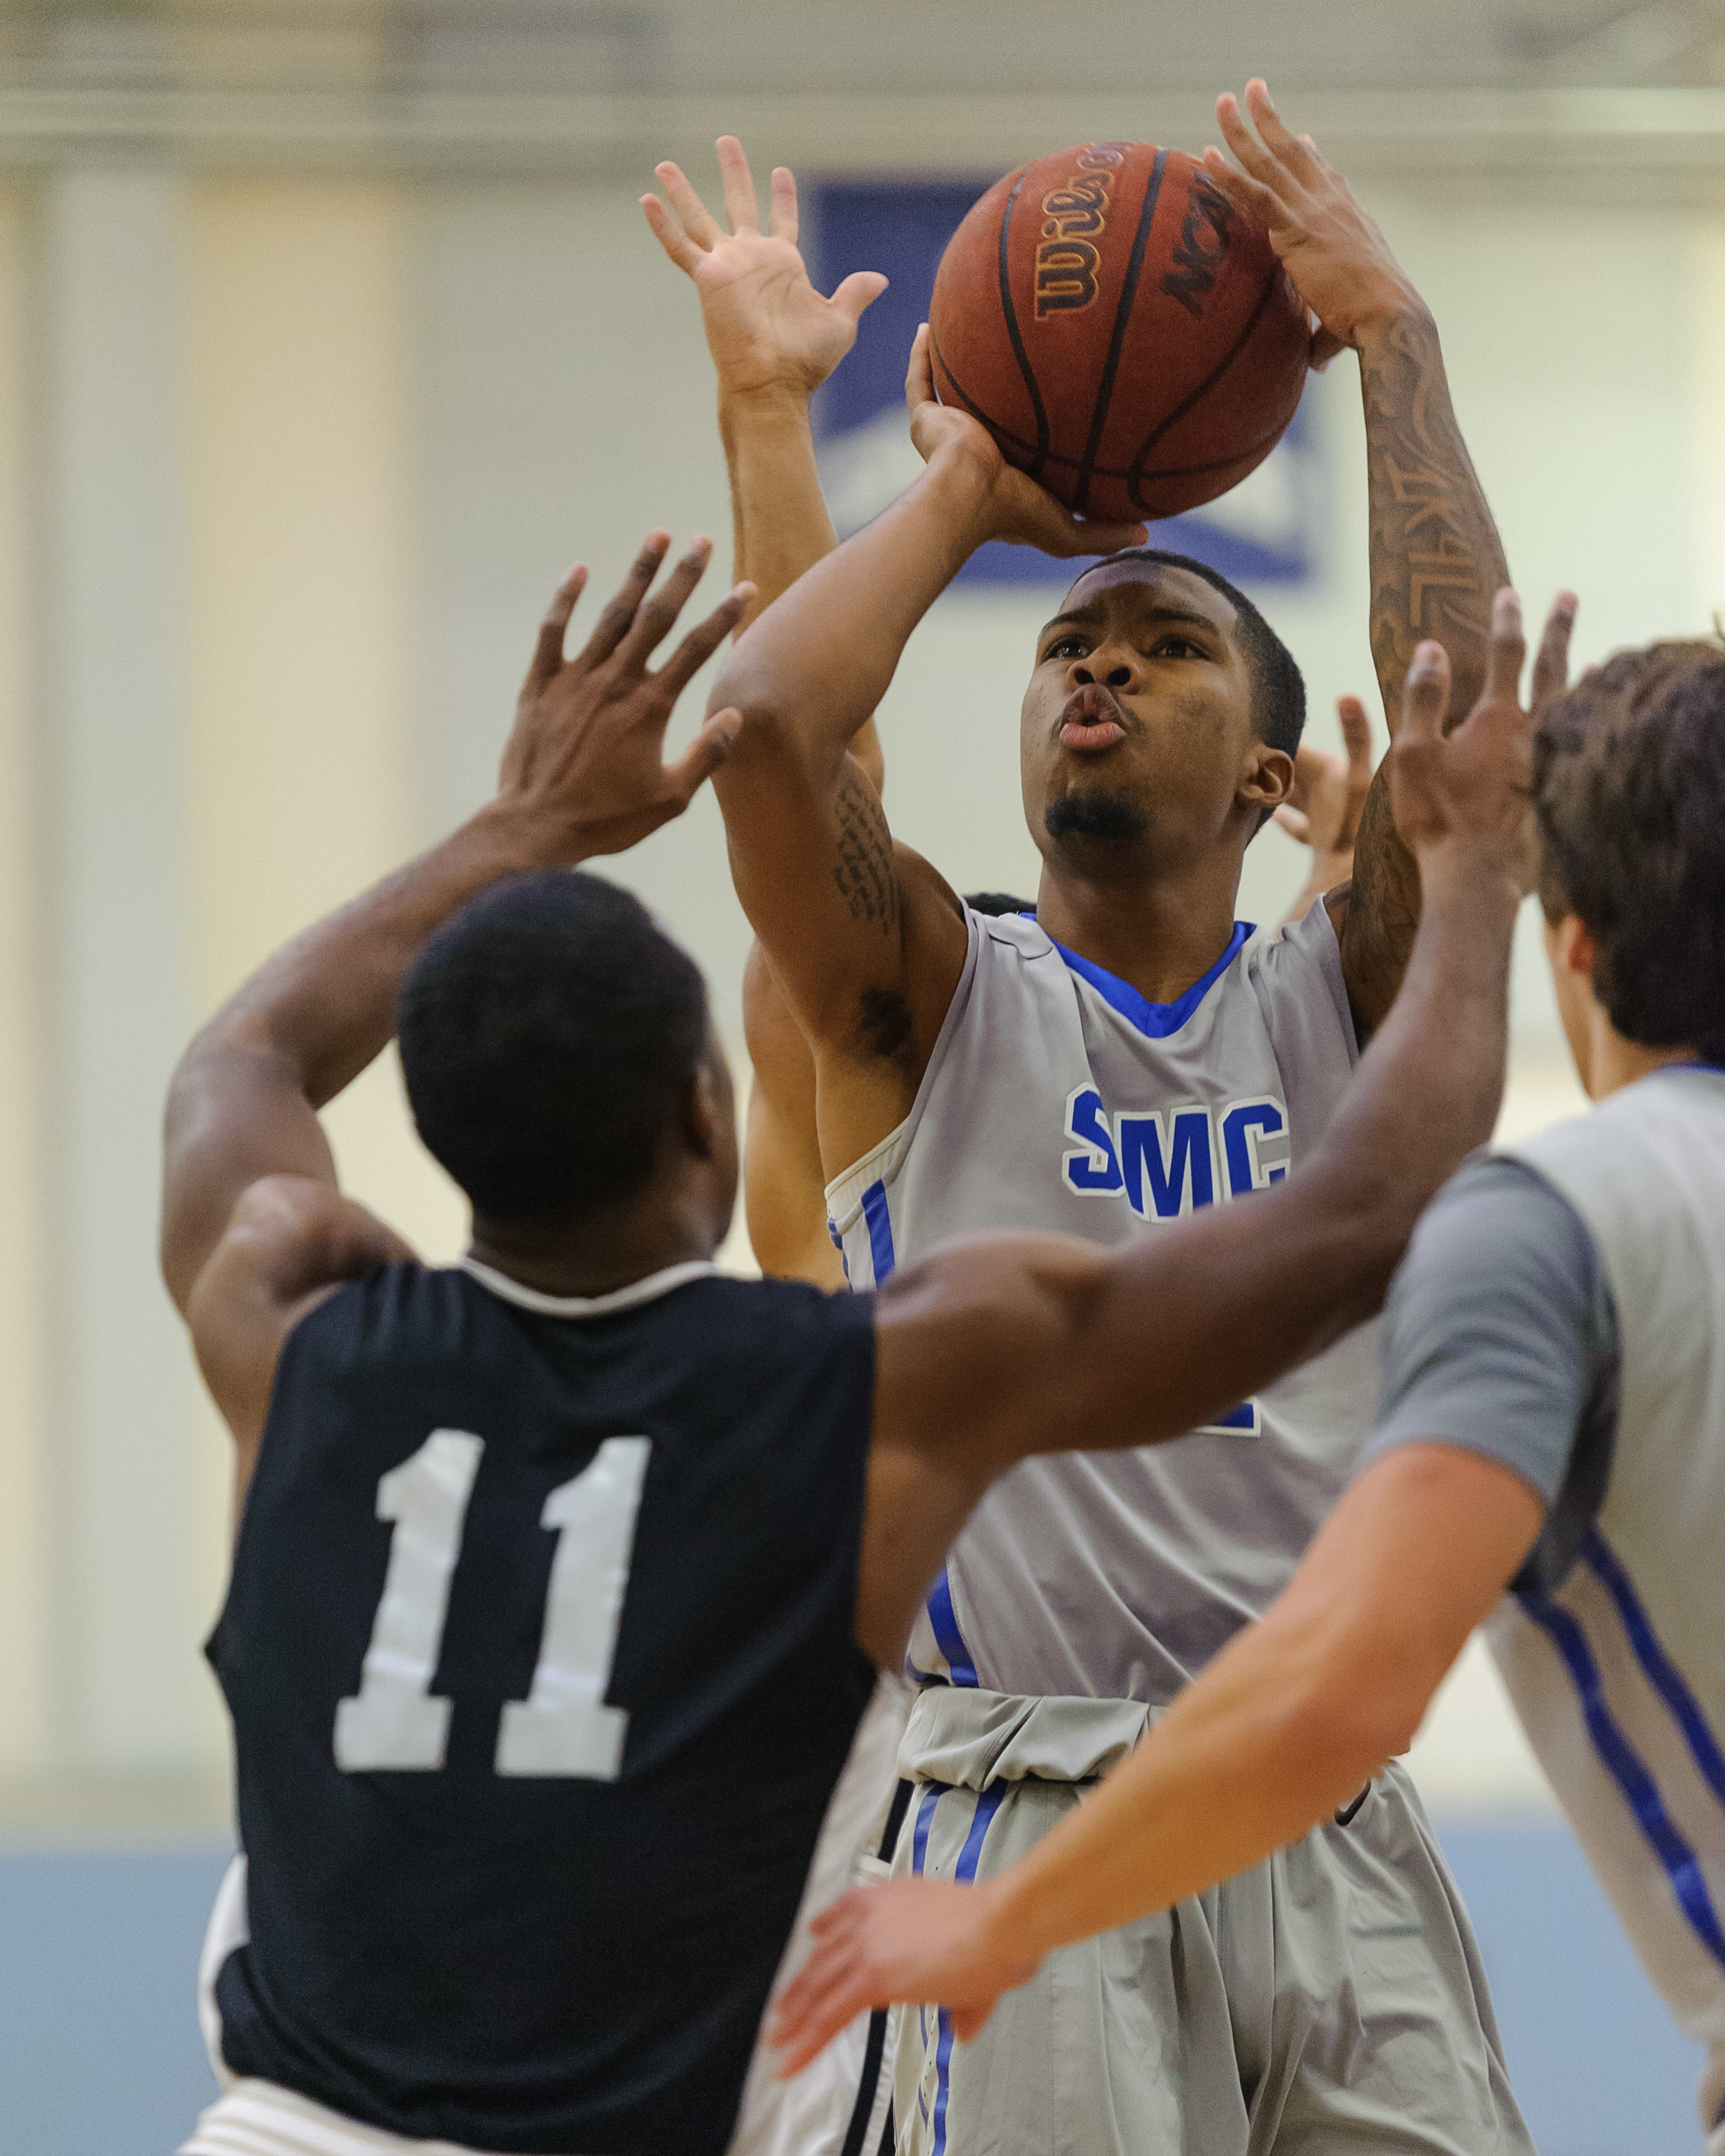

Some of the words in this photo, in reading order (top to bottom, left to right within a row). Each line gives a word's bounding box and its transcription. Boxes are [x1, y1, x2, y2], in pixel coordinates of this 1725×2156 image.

[1034, 142, 1132, 321] Wilso
[1062, 1082, 1290, 1223] SMC
[332, 1427, 654, 1783] 11
